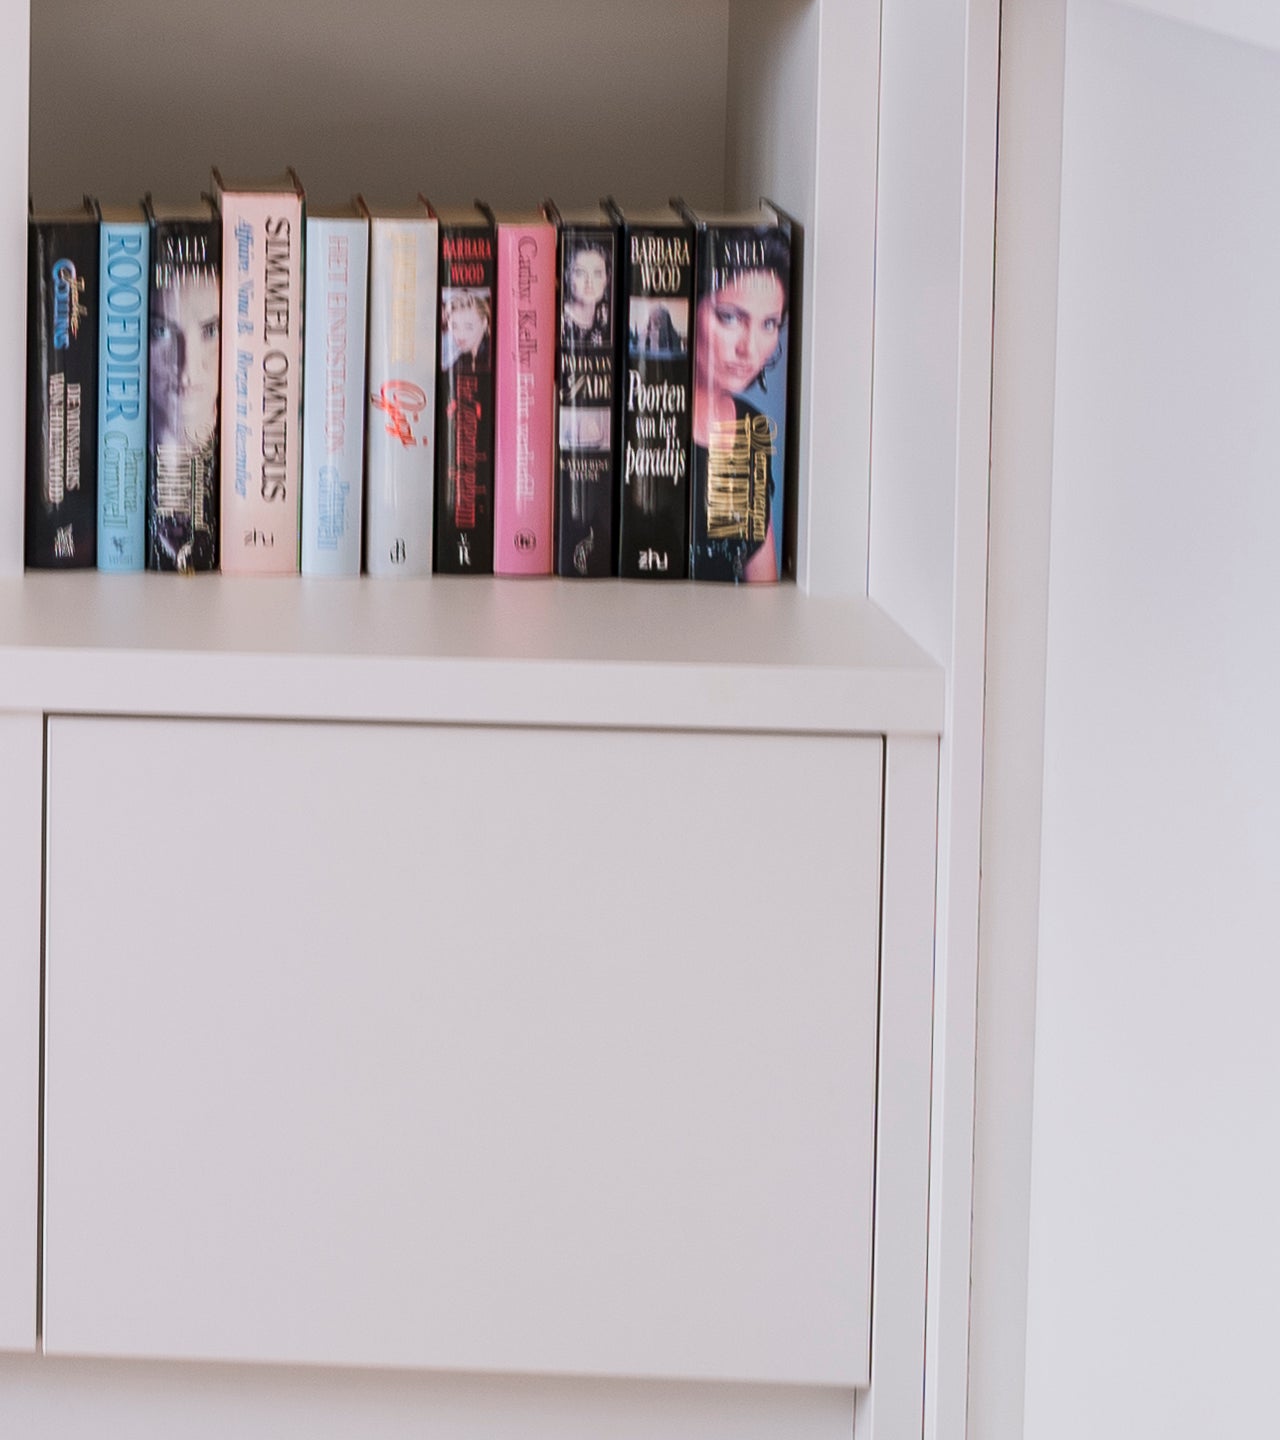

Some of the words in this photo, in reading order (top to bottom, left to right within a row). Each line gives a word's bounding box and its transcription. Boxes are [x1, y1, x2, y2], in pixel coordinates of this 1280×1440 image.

[167, 235, 208, 262] SALLY
[327, 235, 349, 288] HET
[443, 237, 491, 261] BARBARA
[451, 263, 485, 285] WOOD
[518, 235, 538, 304] Cathy
[630, 236, 690, 264] BARBARA
[724, 240, 767, 264] SALLY
[263, 216, 291, 346] SIMMEL
[639, 265, 681, 292] WOOD
[106, 232, 143, 423] ROOFDIER
[516, 309, 537, 368] Kelly
[325, 291, 348, 453] EINDSTATION
[628, 369, 686, 413] Poorten
[261, 349, 289, 504] OMNIBUS
[636, 415, 656, 438] van
[659, 411, 677, 437] het
[103, 431, 128, 528] Cornwell
[626, 435, 686, 486] paradijs
